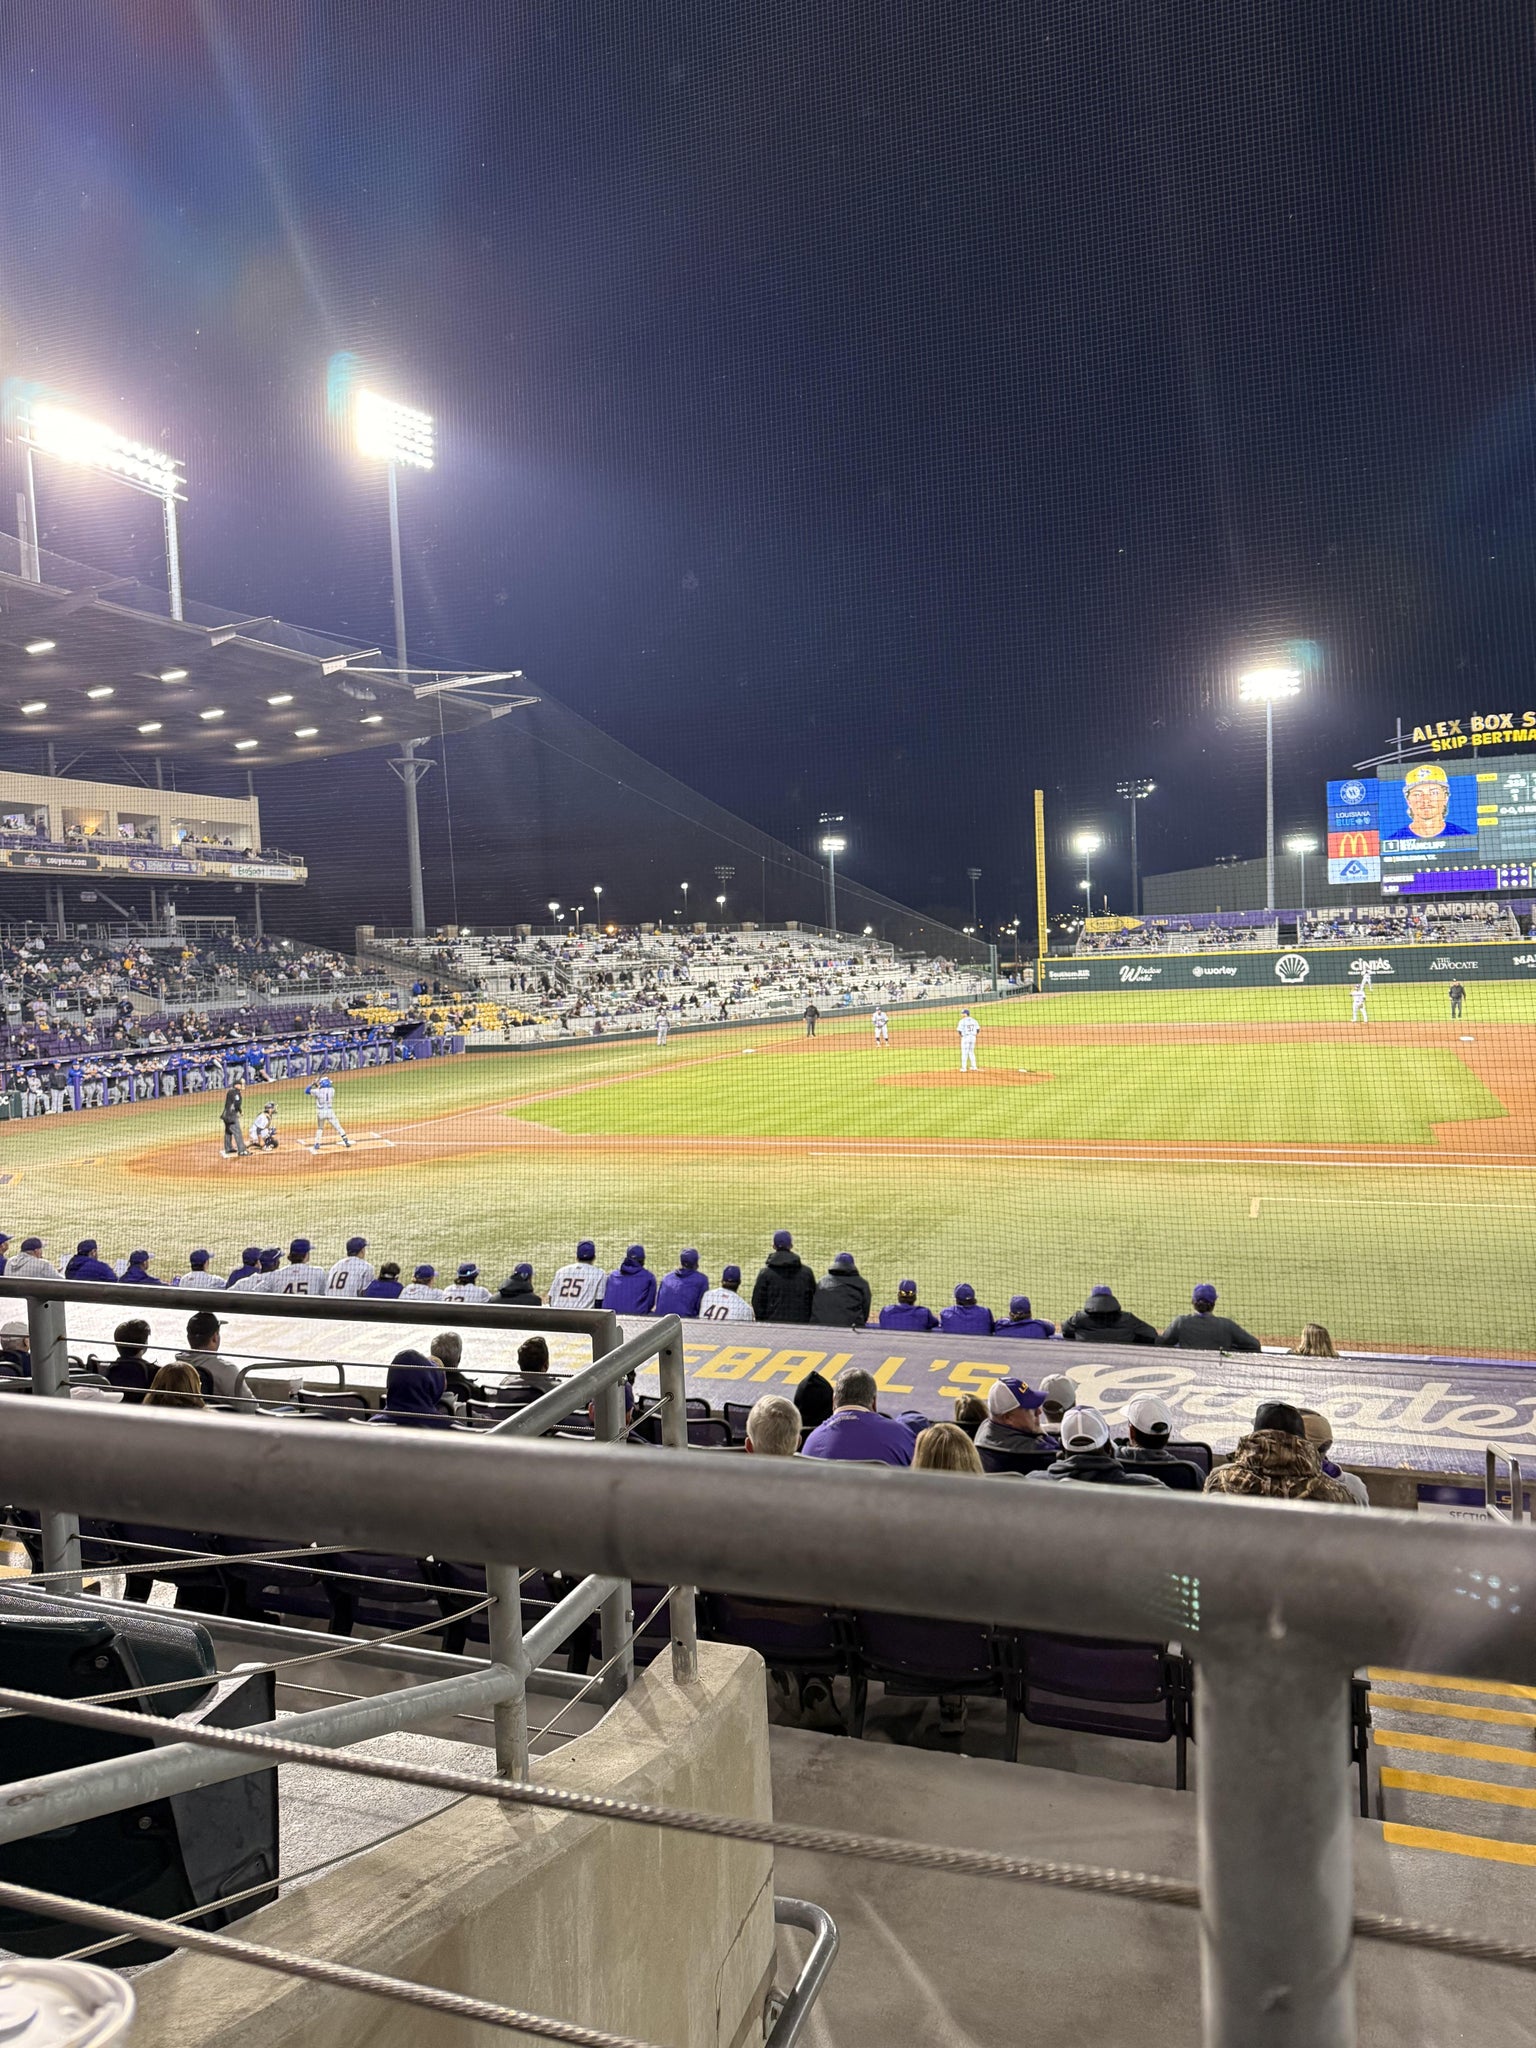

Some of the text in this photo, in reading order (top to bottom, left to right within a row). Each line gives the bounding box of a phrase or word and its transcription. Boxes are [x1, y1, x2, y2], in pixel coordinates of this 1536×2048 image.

[1412, 720, 1462, 743] ALEX
[1471, 713, 1514, 732] BOX
[1431, 736, 1468, 752] SKIP
[1335, 811, 1371, 819] LOUISIANA
[1336, 818, 1356, 827] BLUE
[1306, 901, 1499, 922] LEFT FIELD LANDING
[1204, 966, 1237, 976] worley
[1429, 961, 1478, 971] ADVOCATE
[328, 1271, 349, 1290] 18
[559, 1278, 585, 1298] 25
